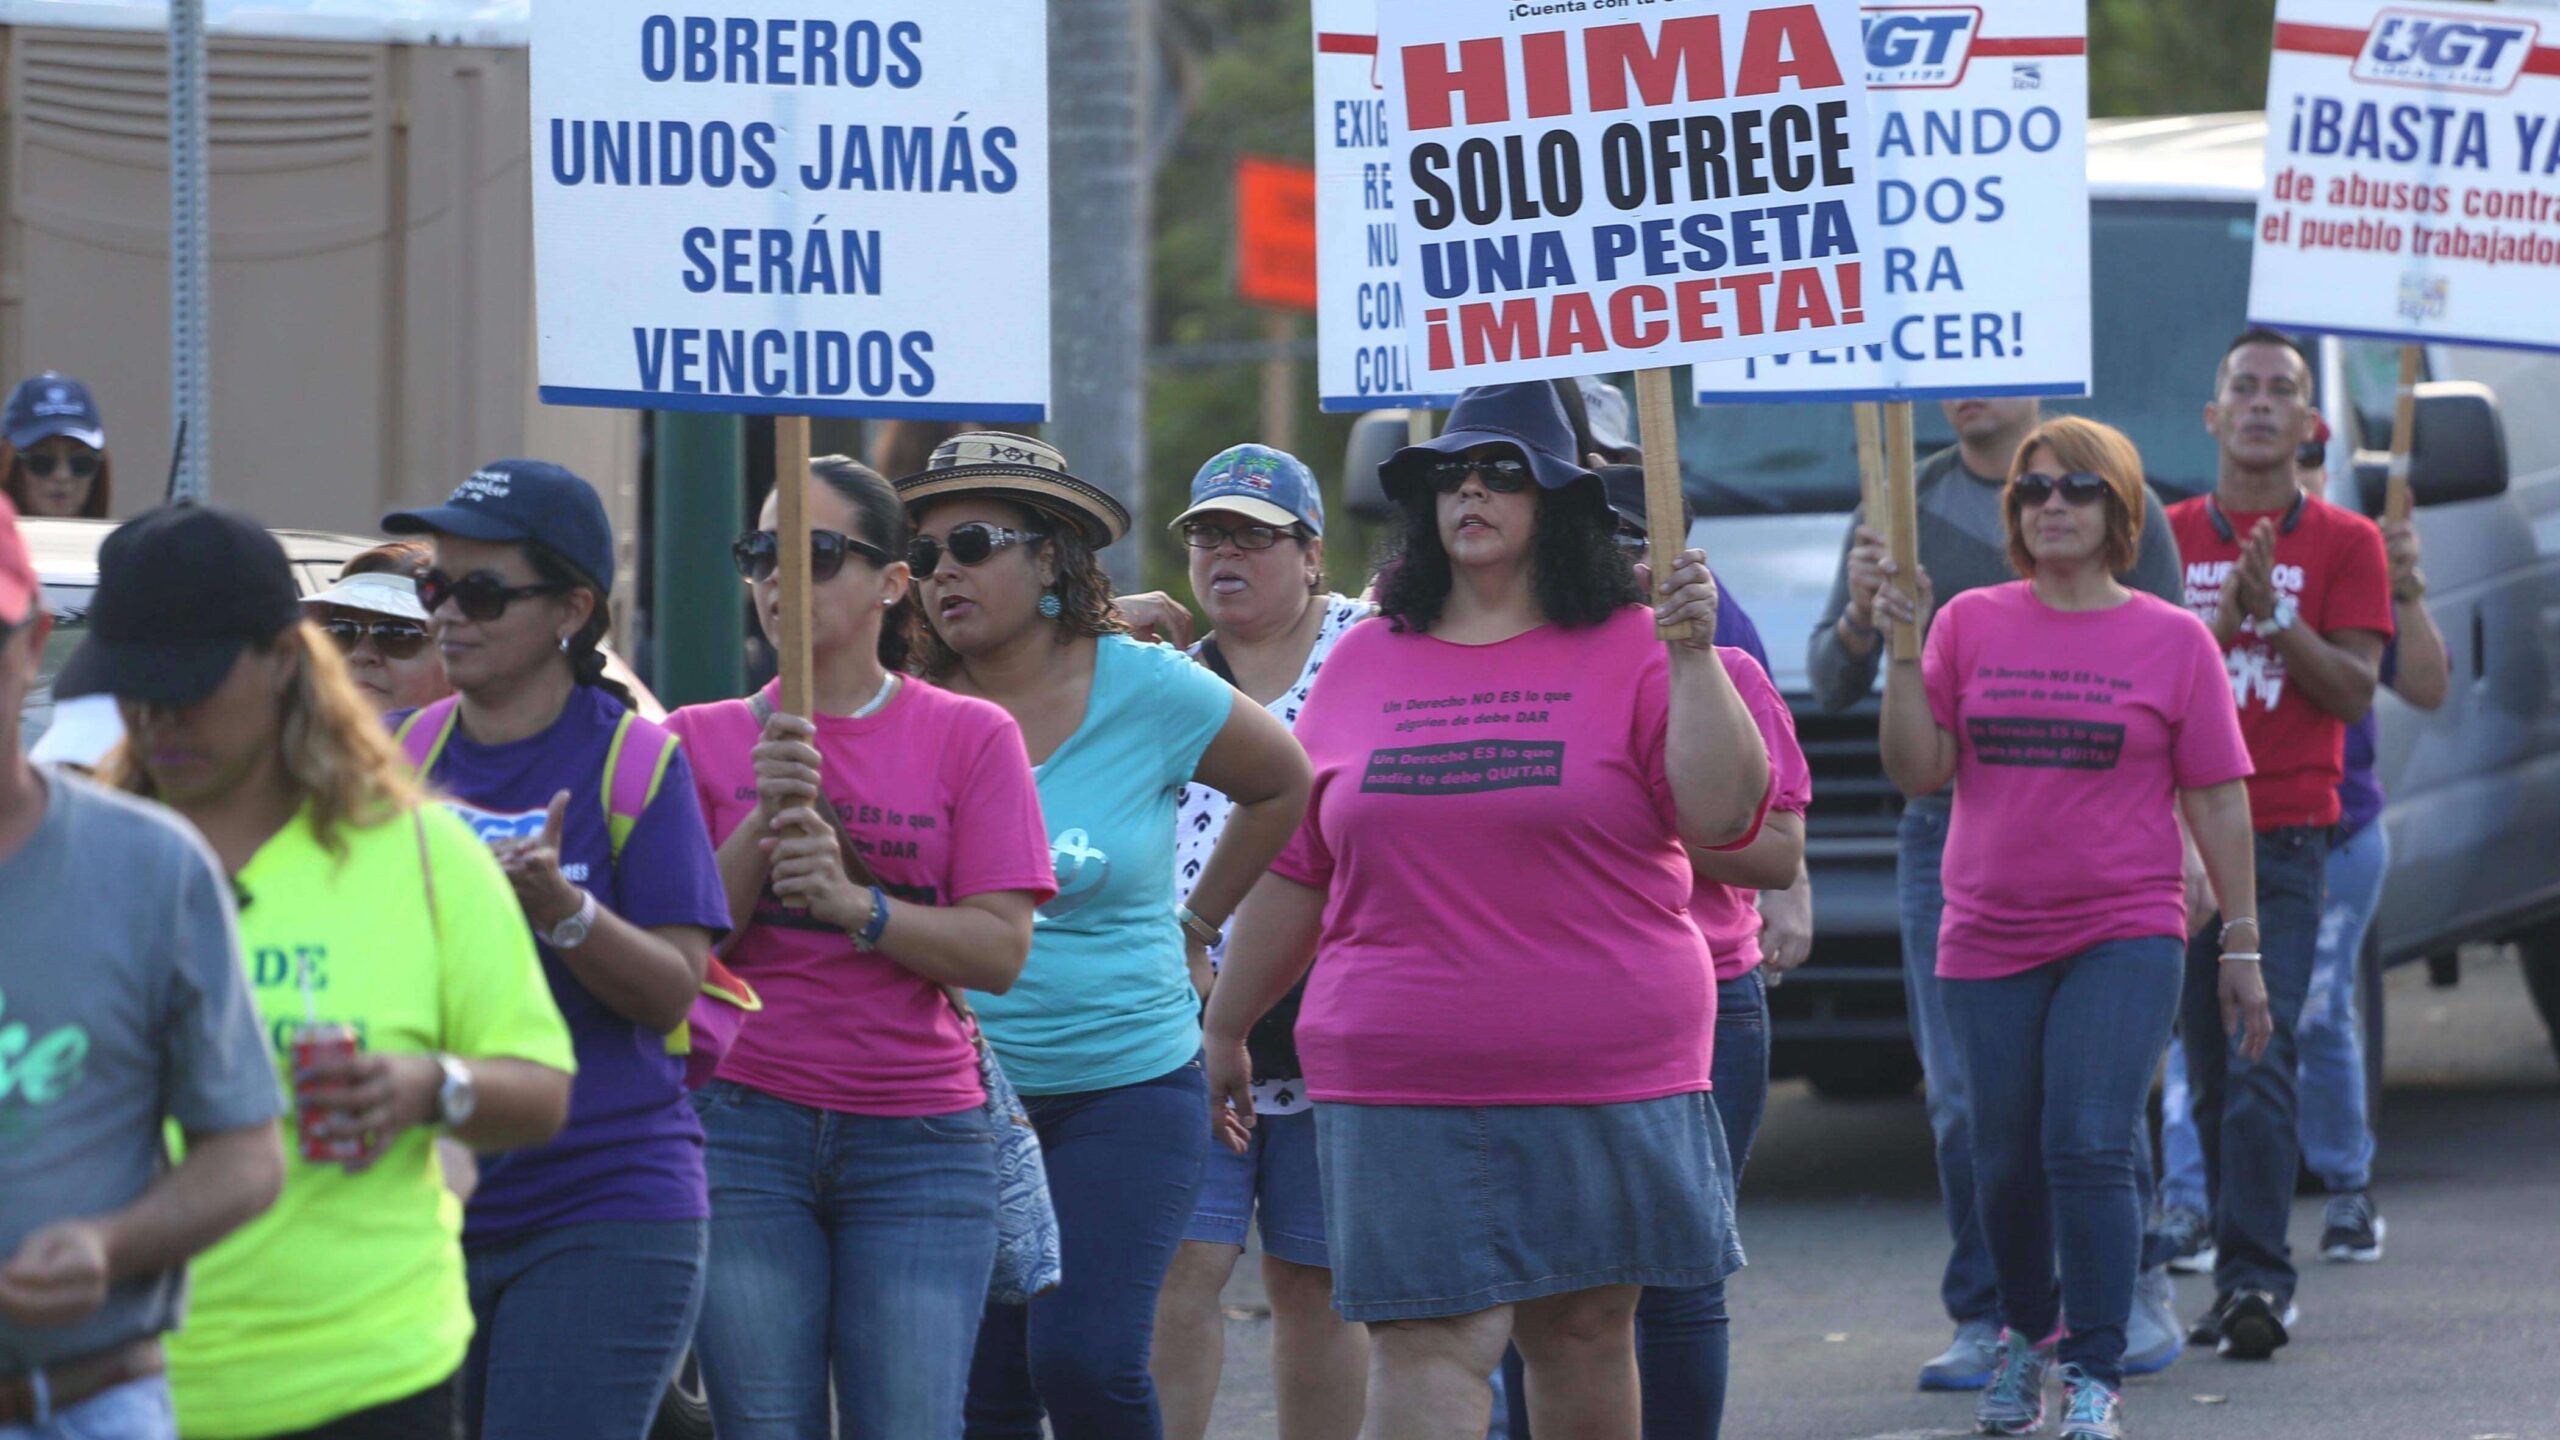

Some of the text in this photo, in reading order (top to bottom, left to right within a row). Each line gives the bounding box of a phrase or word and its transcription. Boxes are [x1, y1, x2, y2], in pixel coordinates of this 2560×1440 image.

[1508, 2, 1587, 21] ¡Cuenta
[641, 14, 922, 89] OBREROS
[1861, 16, 1971, 67] GT
[2372, 18, 2524, 70] UGT
[1401, 5, 1845, 131] HIMA
[1334, 99, 1389, 147] EXIG
[1876, 106, 2061, 157] ANDO
[2289, 96, 2488, 168] ¡BASTA
[550, 111, 1017, 194] UNIDOS JAMÁS
[1408, 100, 1854, 231] SOLO OFRECE
[1364, 163, 1394, 210] RE
[1878, 176, 2005, 226] DOS
[2274, 167, 2315, 203] de
[2328, 172, 2451, 213] abusos
[682, 214, 881, 296] SERÁN
[1366, 223, 1399, 267] NU
[1420, 199, 1859, 299] UNA PESETA
[2261, 210, 2290, 243] el
[2299, 217, 2403, 253] pueblo
[1885, 246, 1964, 293] RA
[1357, 282, 1405, 330] CON
[1425, 262, 1864, 371] ¡MACETA!
[633, 327, 936, 397] VENCIDOS
[1382, 689, 1573, 713] Un Derecho NO ES lo que
[1395, 717, 1447, 732] alguien
[1474, 713, 1511, 725] debe
[1516, 711, 1549, 723] DAR
[1366, 765, 1558, 785] nadie te debe QUITAR
[1373, 747, 1554, 765] Un Derecho ES lo que
[858, 805, 882, 824] ES
[887, 808, 903, 826] lo
[908, 814, 937, 830] que
[879, 839, 920, 859] DAR
[255, 946, 328, 990] DE
